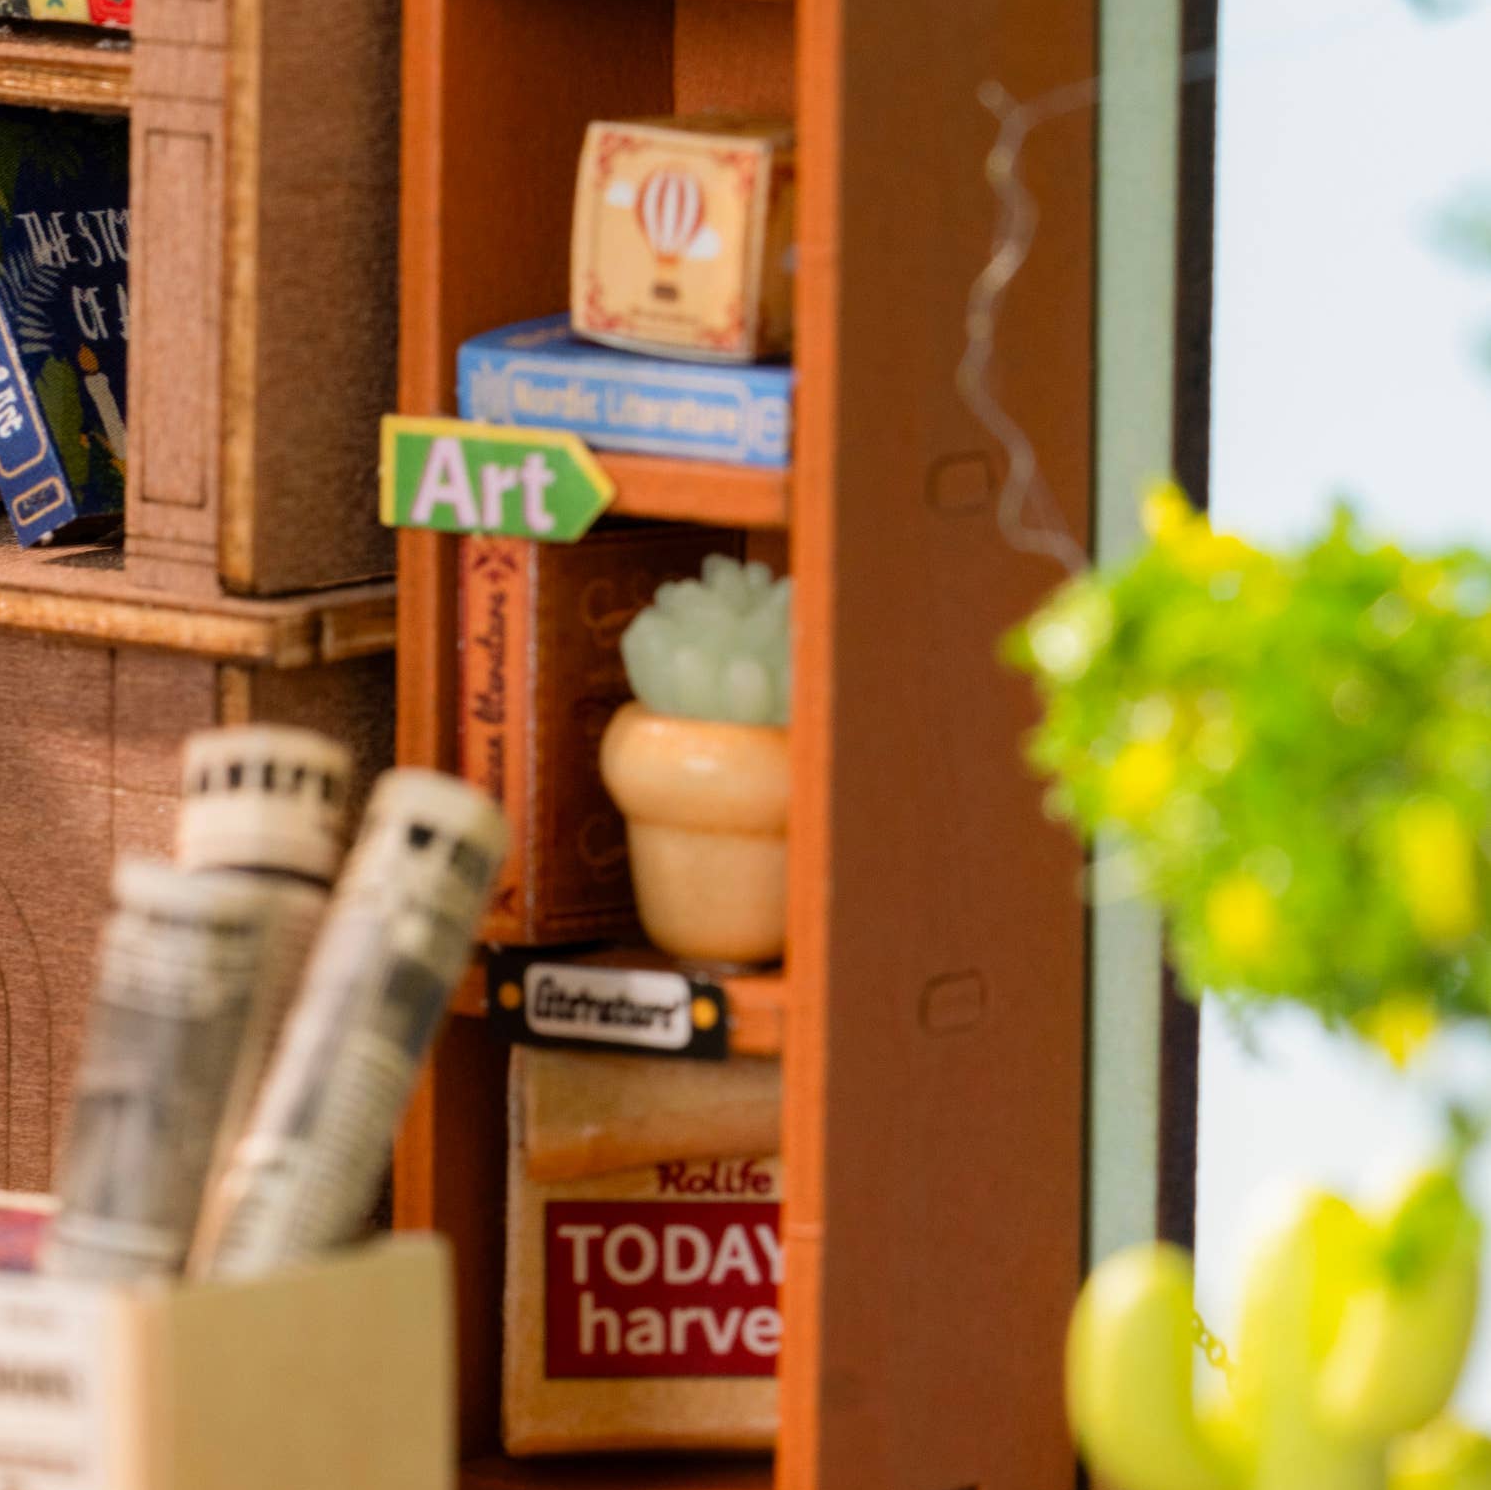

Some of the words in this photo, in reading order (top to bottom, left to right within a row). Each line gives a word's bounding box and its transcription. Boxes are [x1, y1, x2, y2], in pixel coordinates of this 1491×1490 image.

[411, 436, 556, 532] Art
[656, 1159, 774, 1196] Rolife
[557, 1224, 785, 1287] TODAY
[579, 1290, 782, 1357] harve
